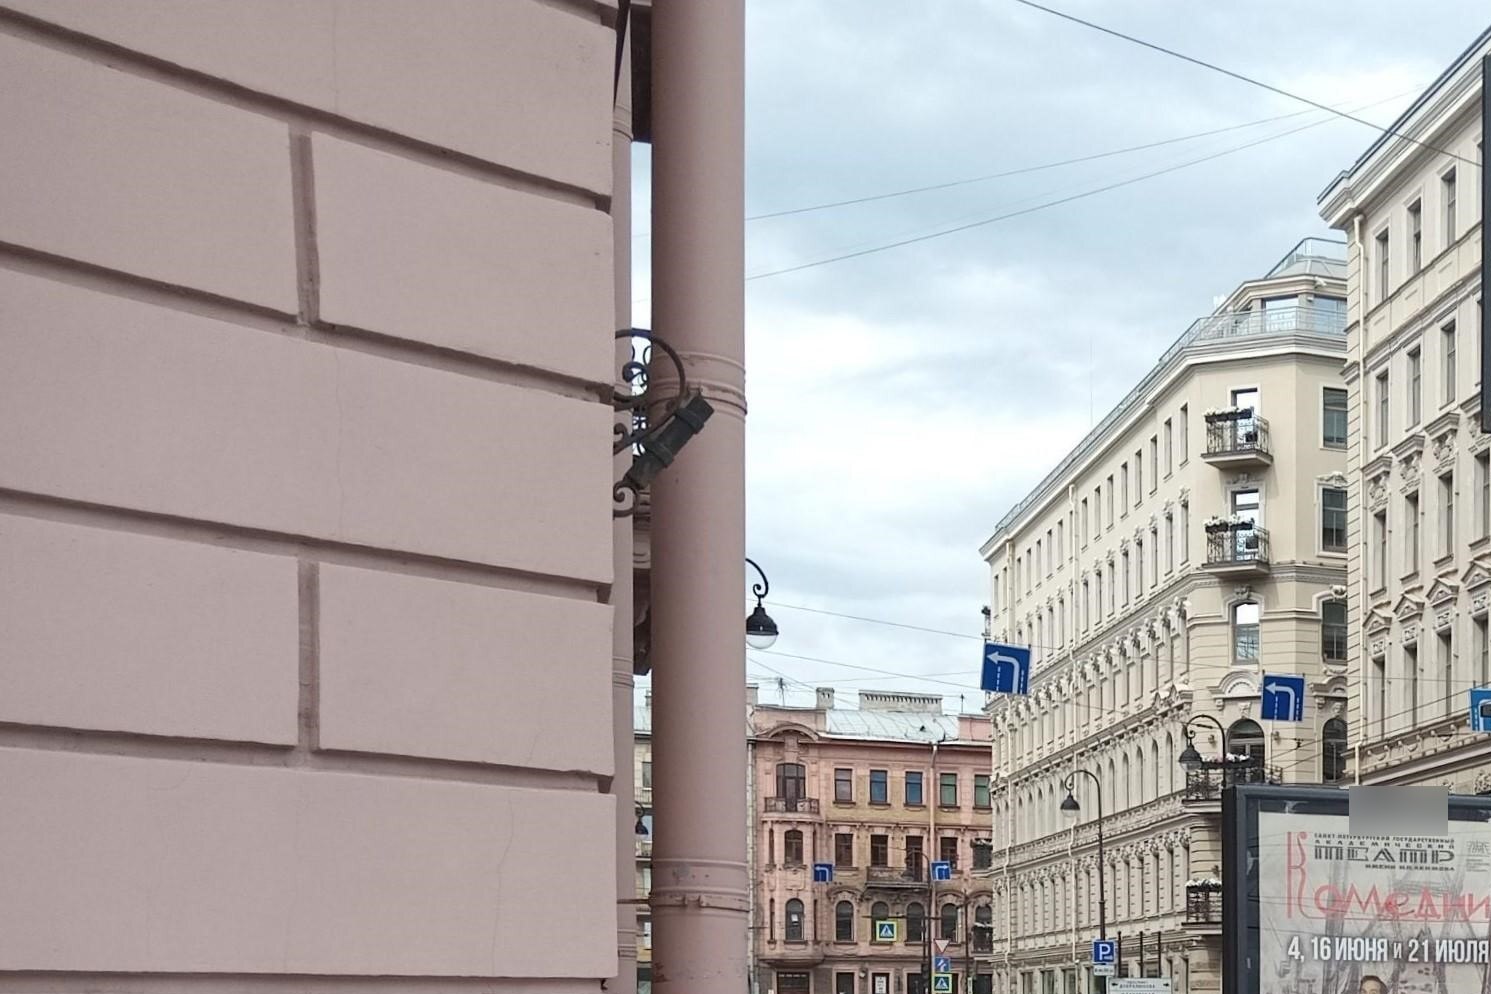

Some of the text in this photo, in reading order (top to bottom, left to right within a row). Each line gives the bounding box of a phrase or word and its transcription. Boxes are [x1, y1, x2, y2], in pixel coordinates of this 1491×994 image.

[1314, 845, 1455, 863] ТЕАТР
[1288, 936, 1305, 962] 4,
[1311, 936, 1332, 960] 16
[1335, 937, 1388, 961] ИЮНЯ
[1408, 938, 1429, 962] 21
[1435, 939, 1489, 963] ИЮЛЯ
